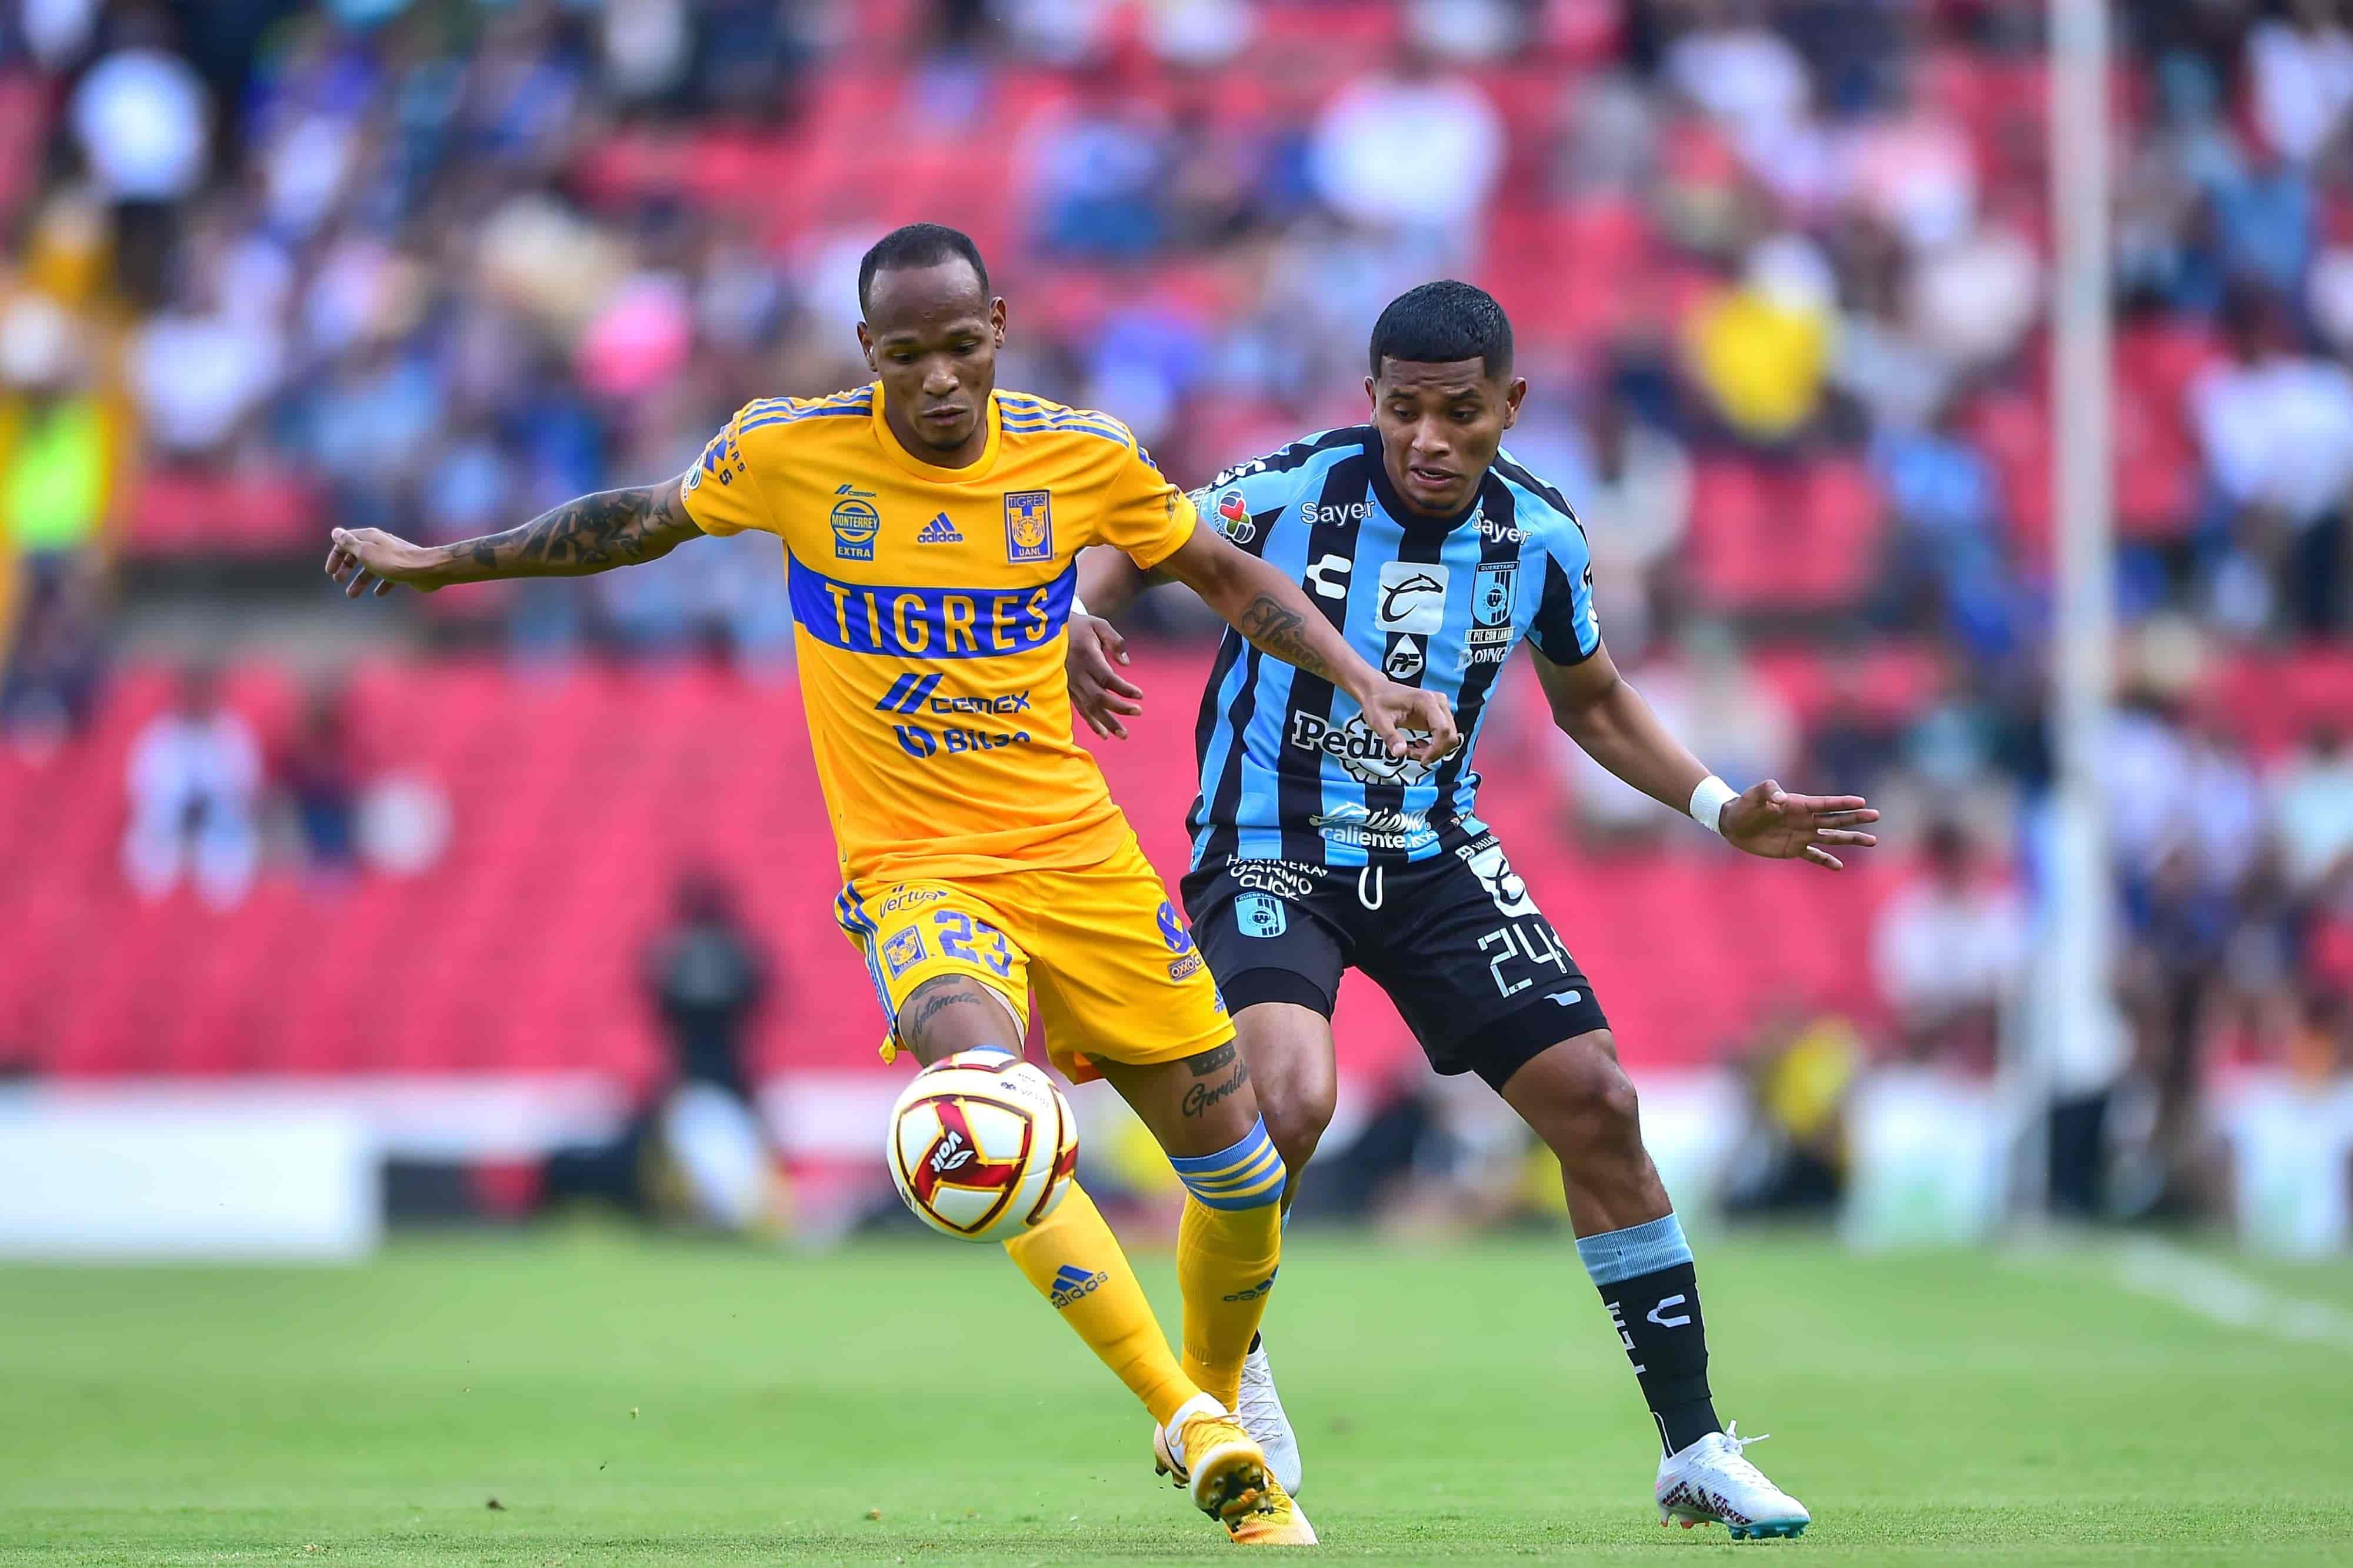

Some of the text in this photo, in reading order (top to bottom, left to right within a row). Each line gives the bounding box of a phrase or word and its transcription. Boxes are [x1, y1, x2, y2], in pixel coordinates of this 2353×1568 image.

[1008, 495, 1045, 508] TIGRES
[832, 514, 878, 531] MONTERREY
[1299, 501, 1376, 526] Sayer
[917, 531, 964, 543] adidas
[1471, 509, 1533, 545] Sayer
[837, 546, 871, 558] EXTRA
[1018, 548, 1042, 556] UANL
[825, 582, 1048, 653] TIGRES
[1473, 631, 1484, 642] PIE
[1239, 874, 1299, 901] CLICK
[934, 910, 1012, 977] 23
[1171, 959, 1194, 977] OXXO
[1477, 923, 1568, 998] 24
[1052, 1270, 1108, 1310] adidas
